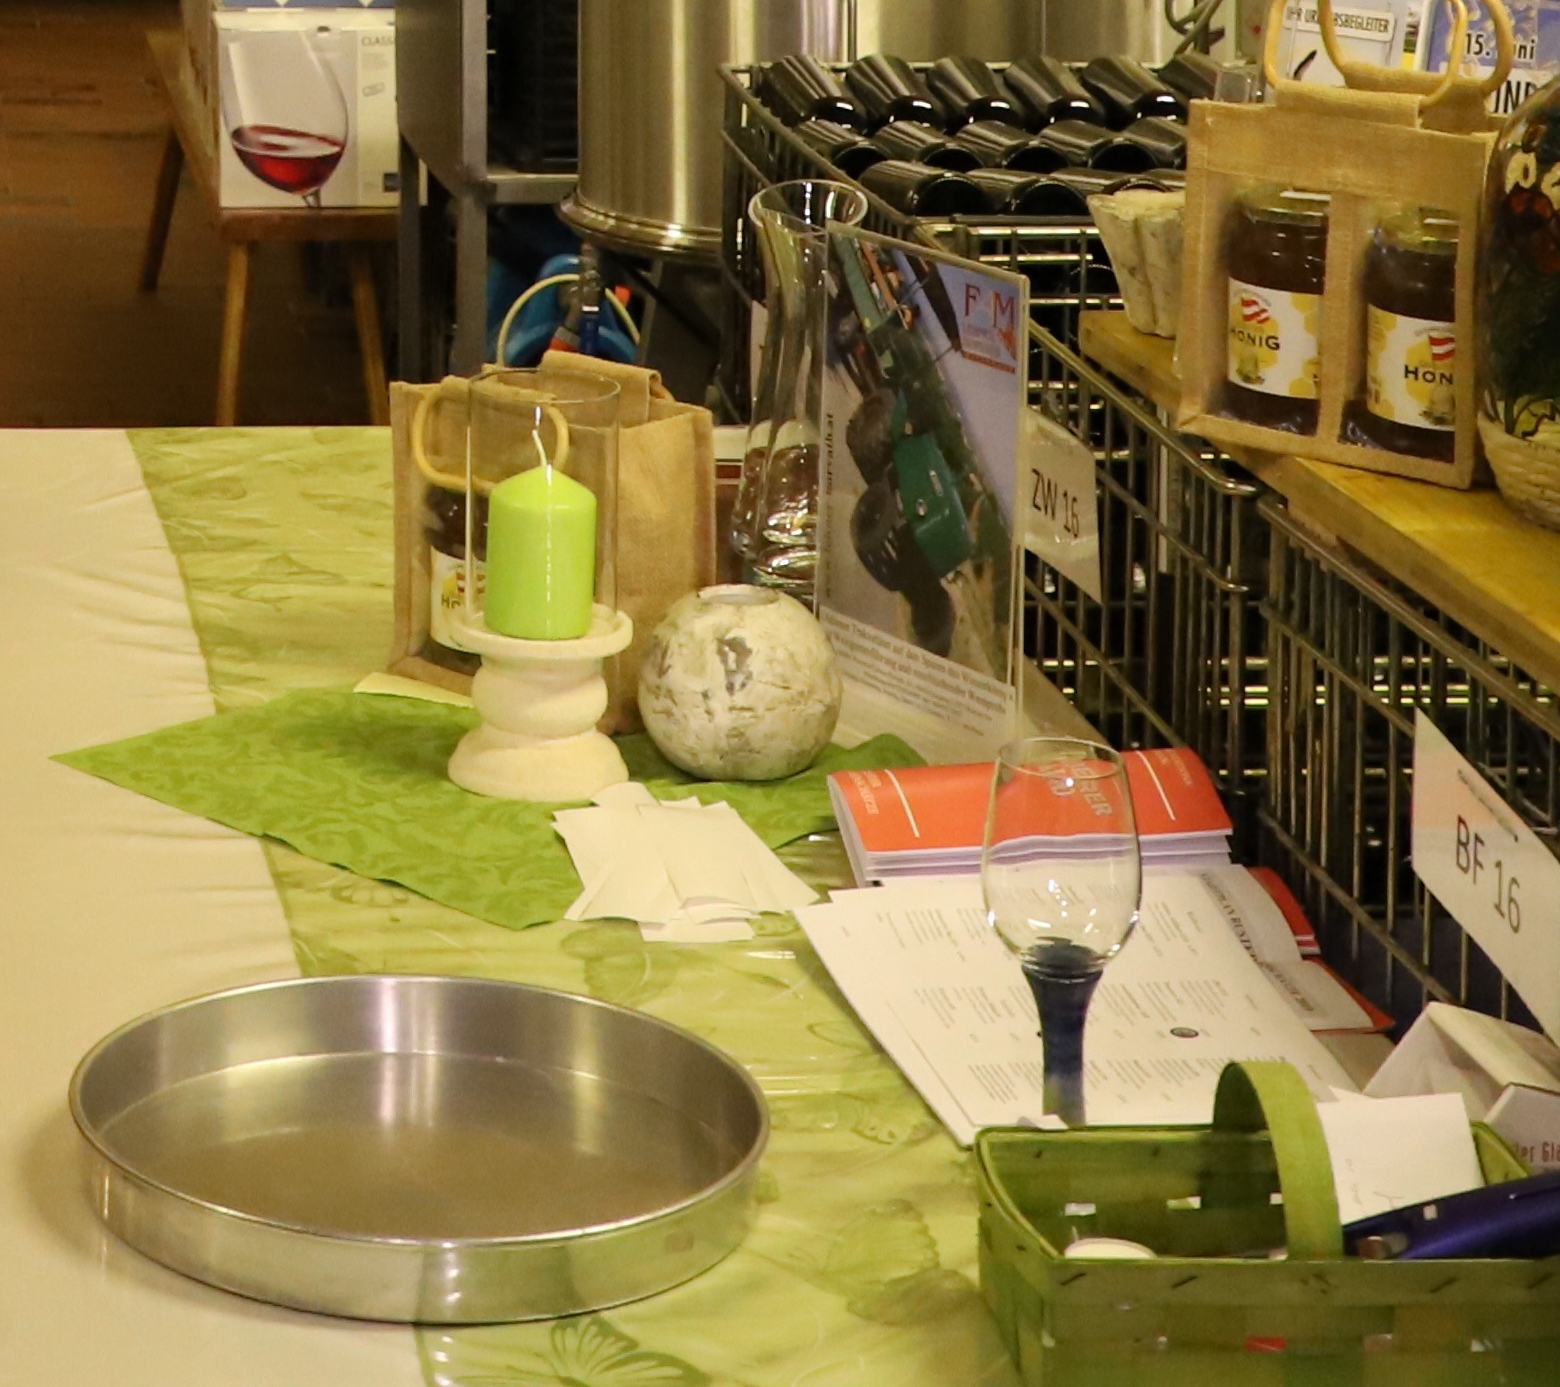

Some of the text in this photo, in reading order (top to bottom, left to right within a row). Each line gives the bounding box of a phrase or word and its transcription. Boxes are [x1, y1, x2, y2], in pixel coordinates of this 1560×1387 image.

[1031, 467, 1081, 540] ZW 16
[1455, 814, 1522, 935] BF 16
